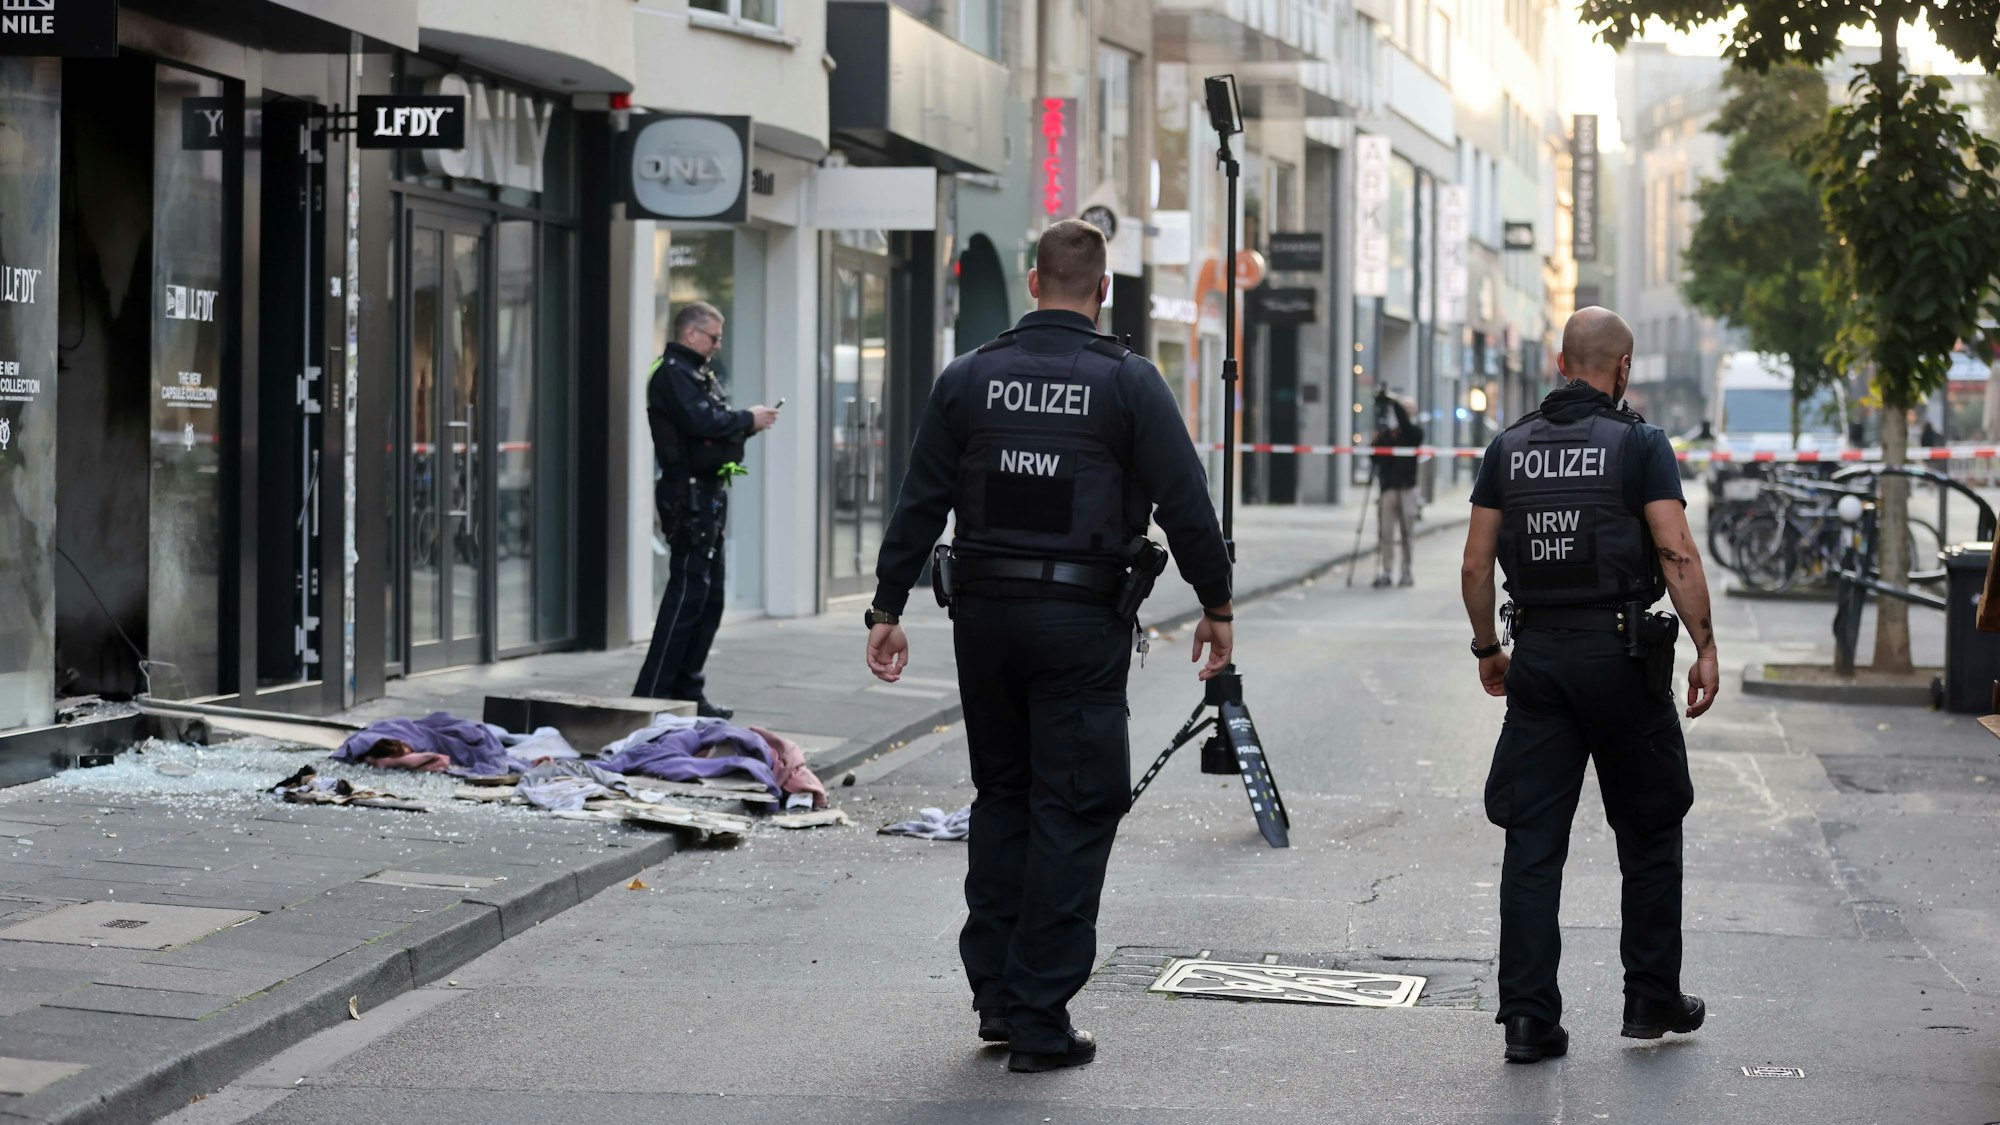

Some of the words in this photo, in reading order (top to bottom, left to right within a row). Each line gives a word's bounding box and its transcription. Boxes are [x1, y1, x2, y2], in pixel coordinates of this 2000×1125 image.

[2, 15, 55, 34] NILE
[373, 107, 446, 136] LFDY
[640, 154, 734, 181] ONLY
[1363, 142, 1382, 292] ARKET
[4, 265, 37, 304] LFDY
[189, 287, 215, 322] LFDY
[4, 361, 20, 376] NEW
[0, 378, 41, 393] COLLECTION
[162, 385, 187, 400] CAPSULE
[186, 387, 218, 402] COLLECTION
[986, 380, 1091, 416] POLIZEI
[1000, 449, 1061, 477] NRW
[1510, 447, 1606, 481] POLIZEI
[1526, 510, 1581, 535] NRW
[1531, 537, 1575, 561] DHF
